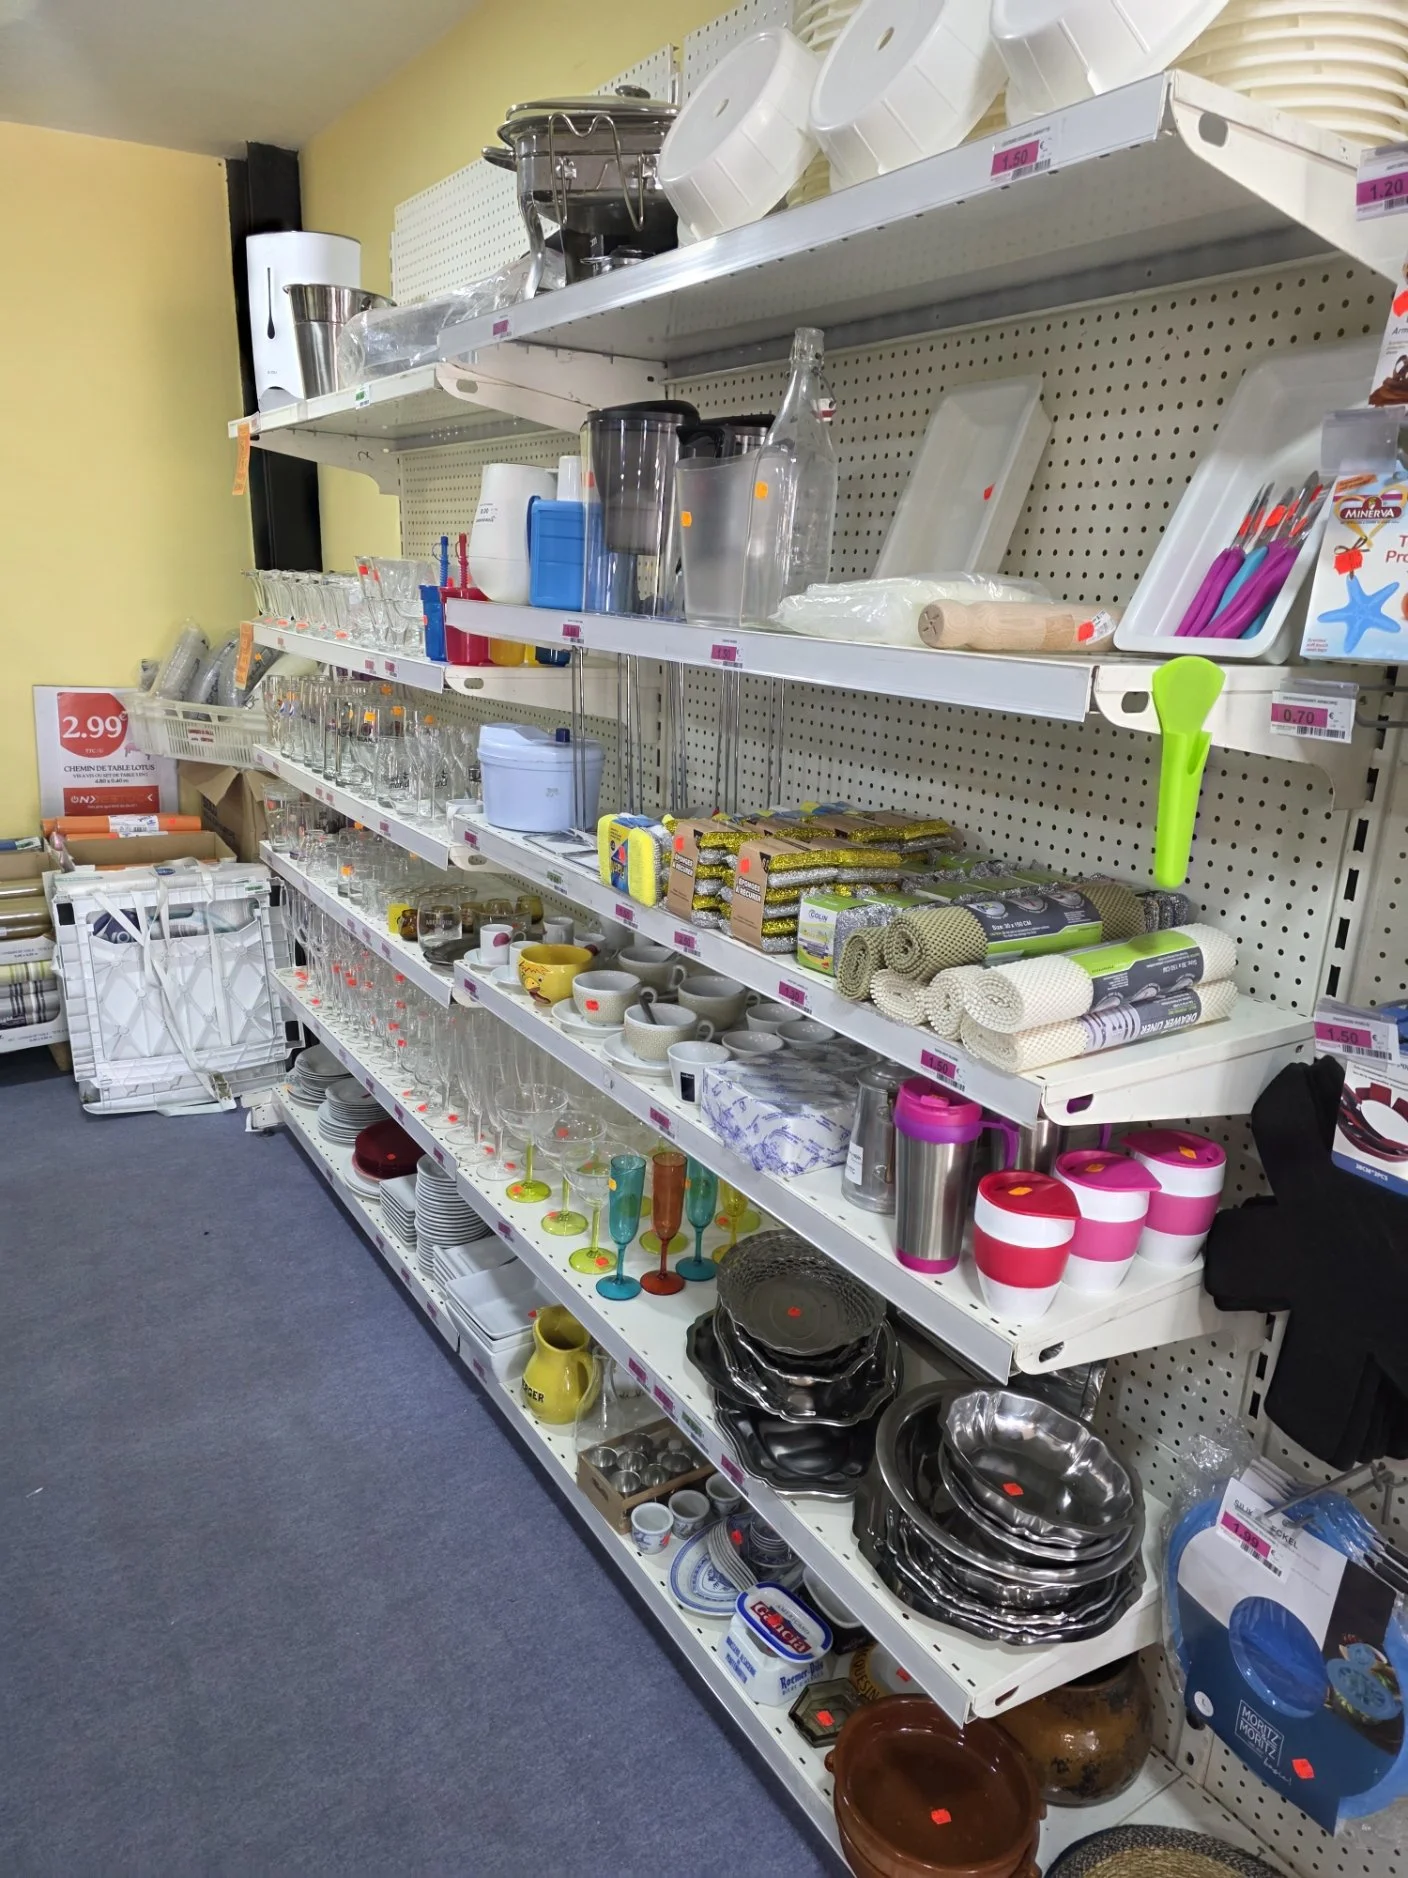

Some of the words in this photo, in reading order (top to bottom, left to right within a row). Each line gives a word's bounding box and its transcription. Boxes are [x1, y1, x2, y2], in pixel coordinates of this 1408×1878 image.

[1002, 149, 1028, 170] 1.50
[1370, 179, 1404, 200] 1.20
[1344, 507, 1395, 520] MINERVA
[1283, 709, 1315, 725] 0.70
[61, 716, 122, 739] 2.99
[64, 765, 96, 773] CHEMIN
[108, 764, 131, 772] TABLE
[131, 763, 155, 771] LOTUS
[1140, 1019, 1166, 1035] LINER
[1166, 1012, 1198, 1028] DRAWER
[1327, 1027, 1360, 1044] 1.50
[929, 1056, 949, 1074] 1.50
[1233, 1522, 1260, 1549] 1.99
[1242, 1706, 1281, 1746] MORITZ
[1239, 1719, 1277, 1760] MORITZ
